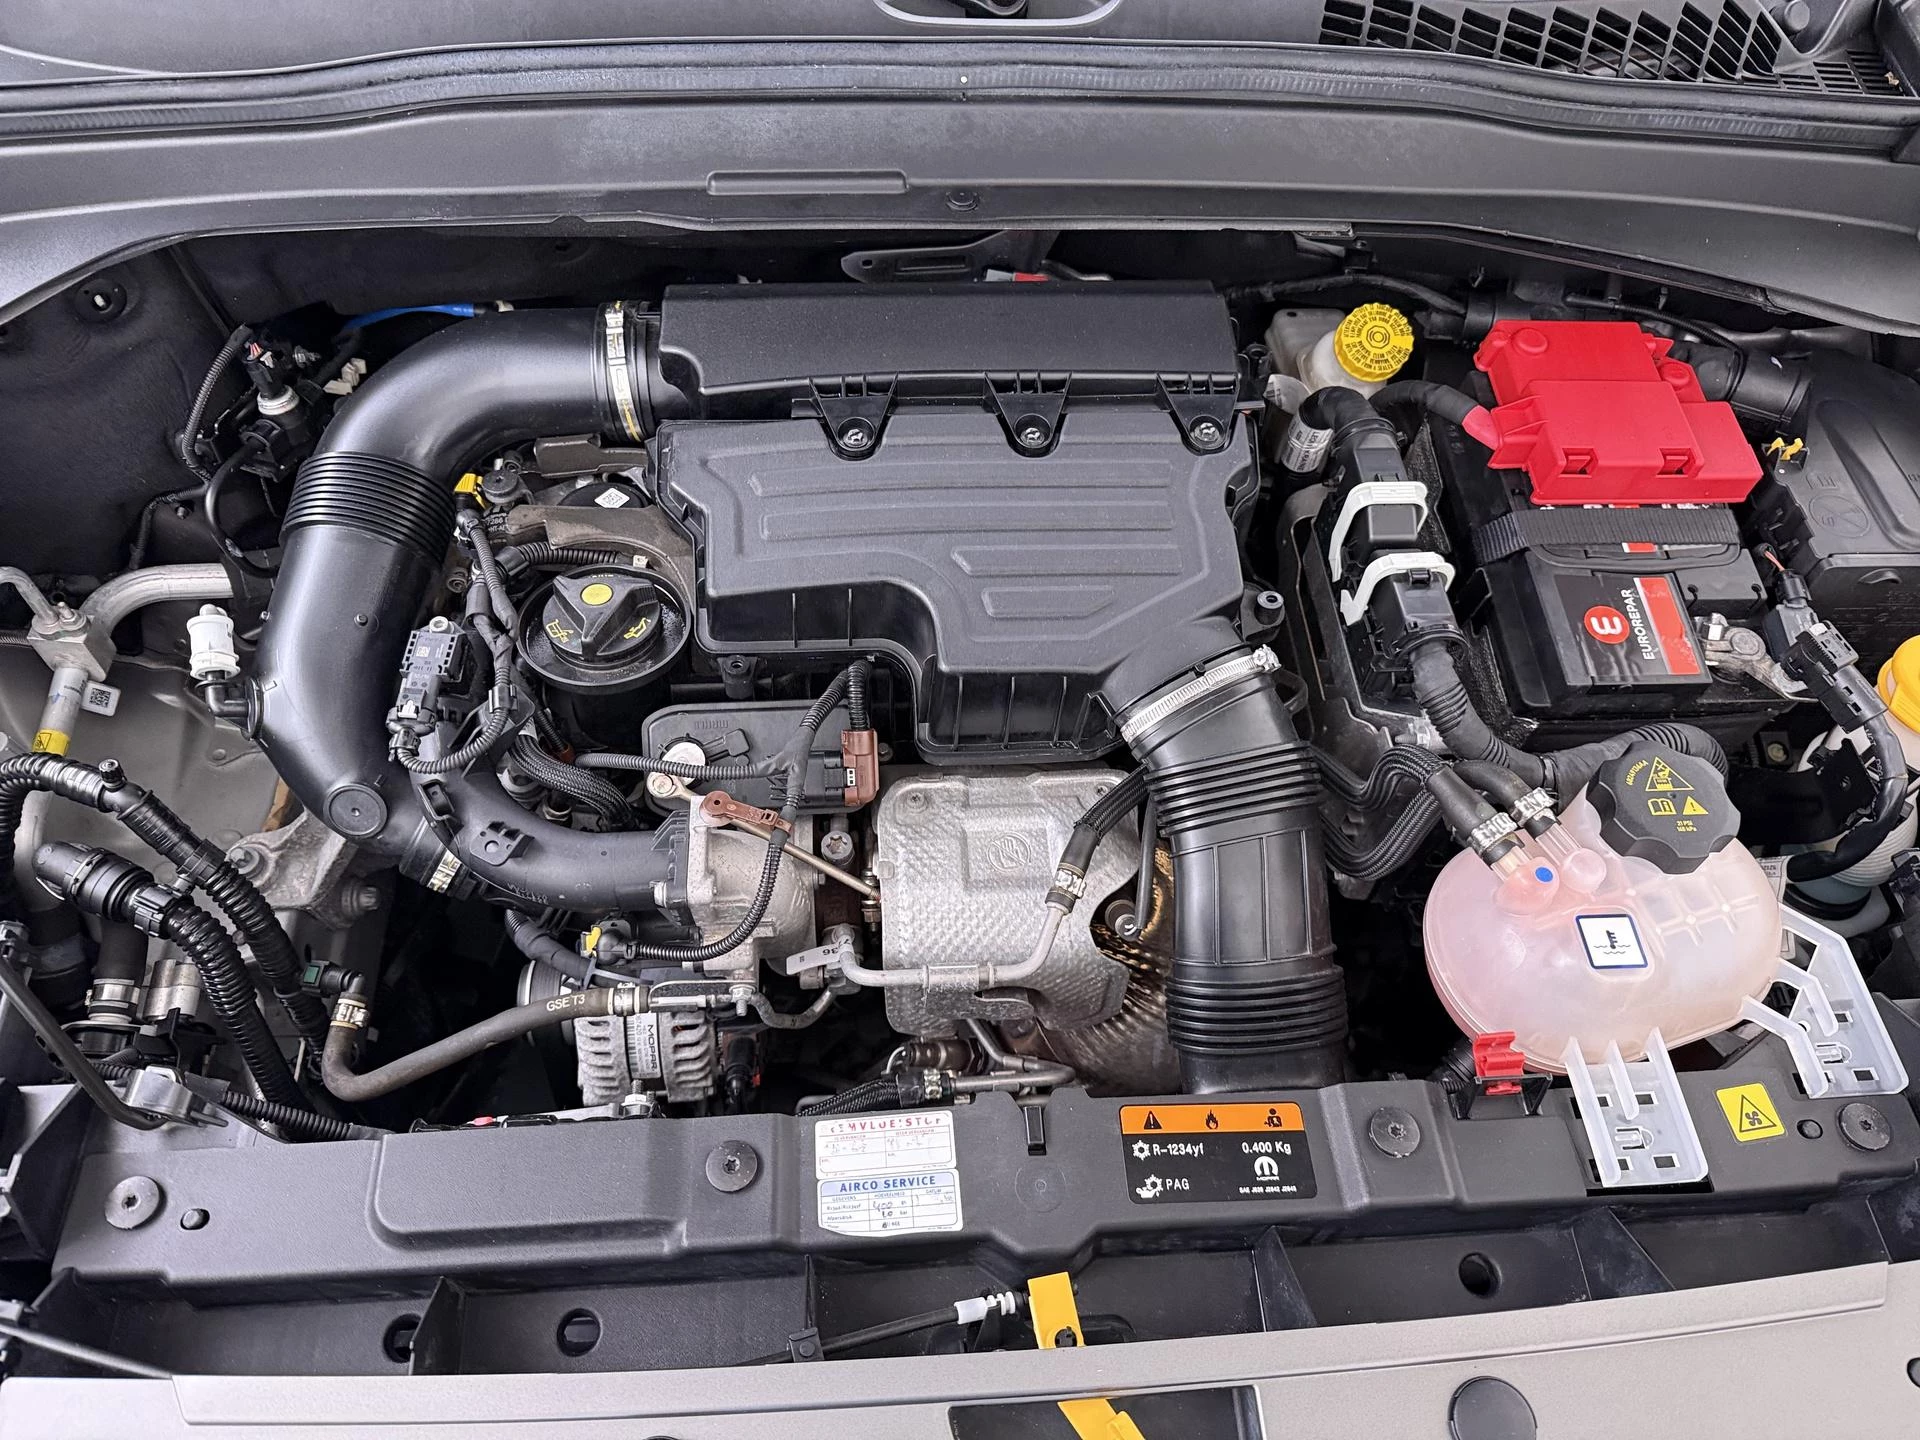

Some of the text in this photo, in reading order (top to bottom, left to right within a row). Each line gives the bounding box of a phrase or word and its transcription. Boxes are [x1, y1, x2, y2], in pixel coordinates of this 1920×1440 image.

[1620, 589, 1655, 660] EUROREPAR
[546, 994, 586, 1012] GSE T3
[647, 1024, 658, 1072] MOPAR
[1152, 1142, 1204, 1157] R-1234yf
[1241, 1141, 1292, 1155] 0.400 Kg
[840, 1175, 936, 1193] AIRCO SERVICE
[1165, 1178, 1190, 1191] PAG
